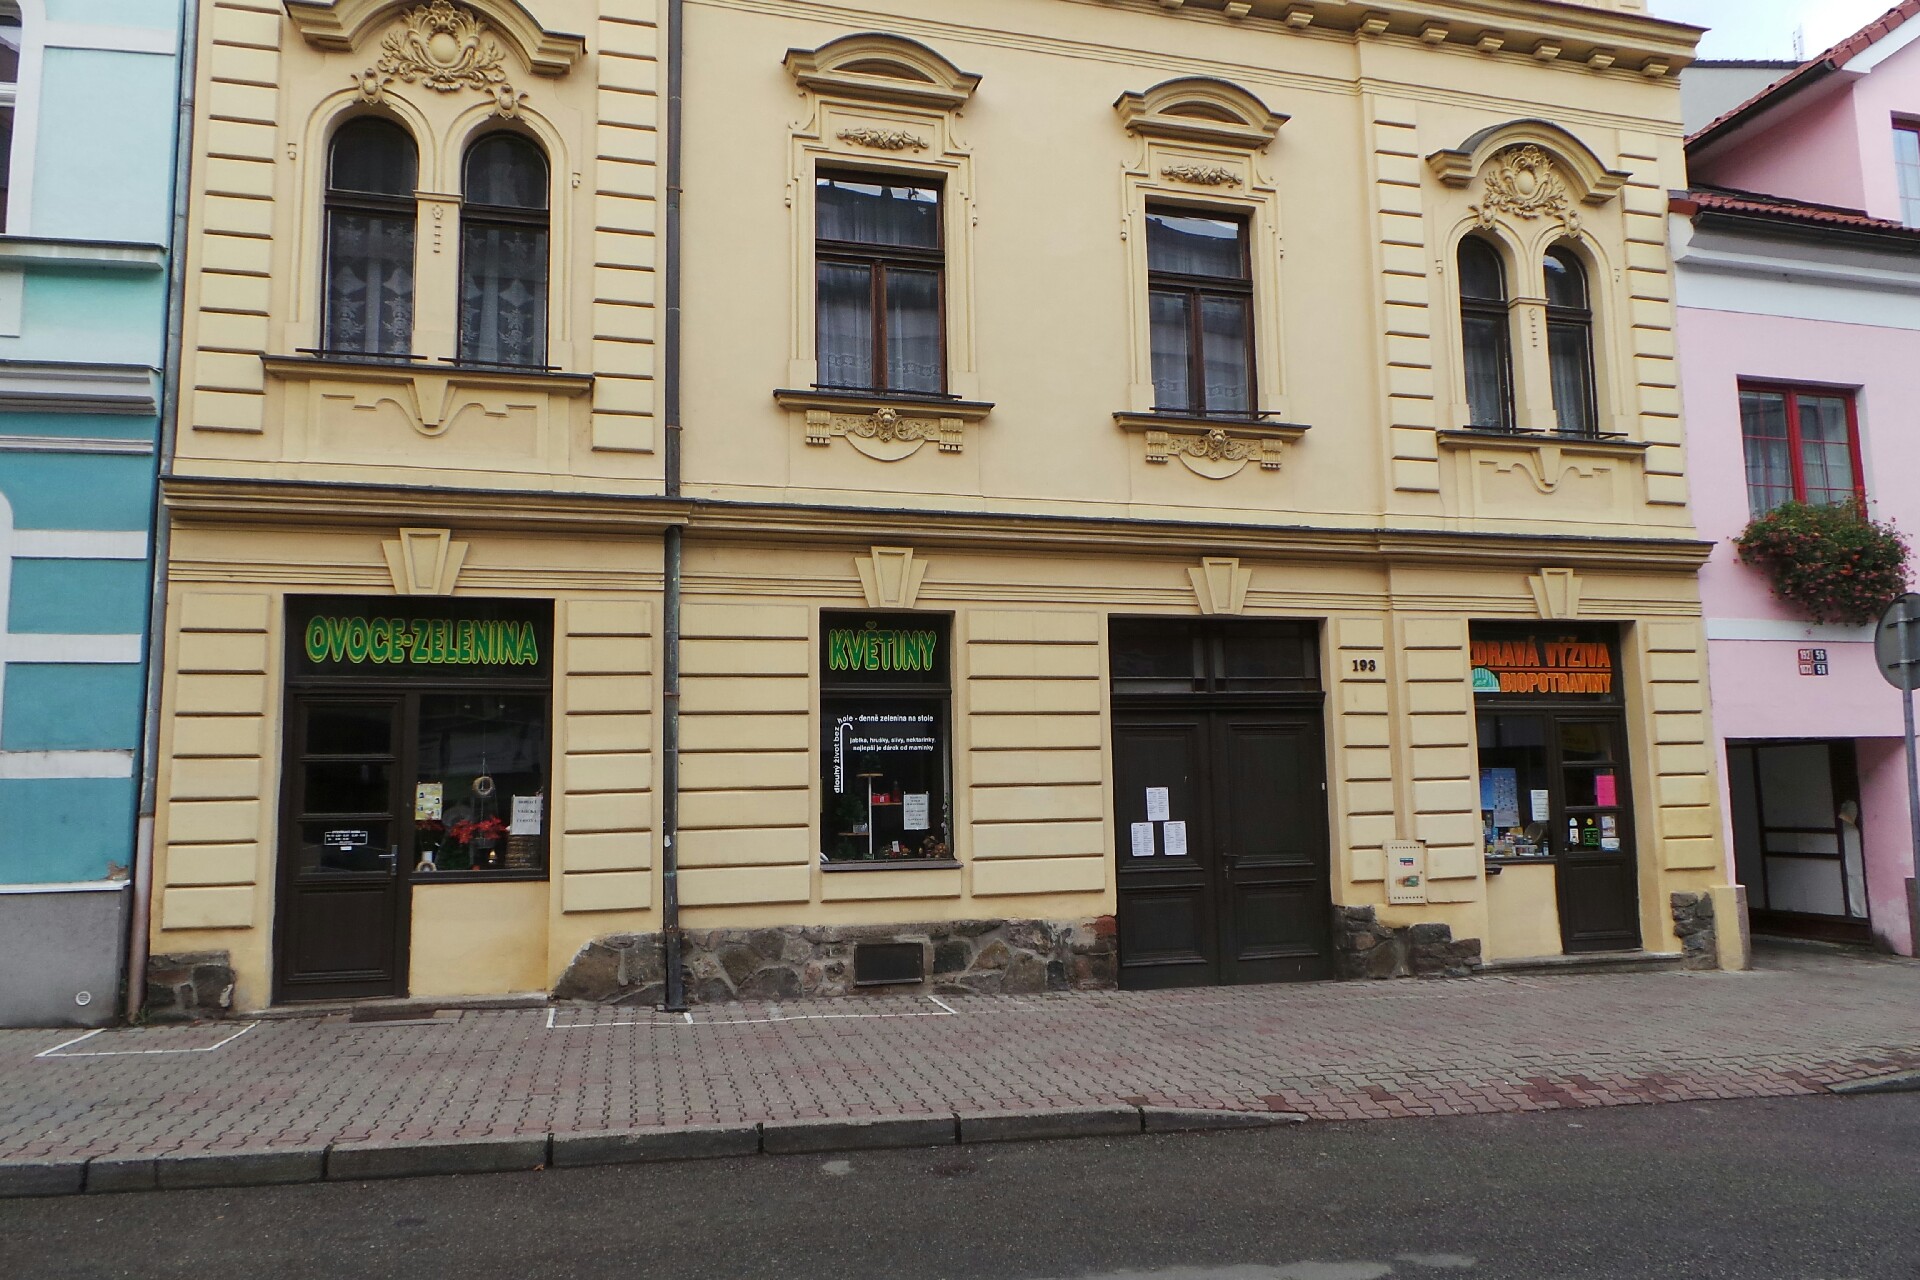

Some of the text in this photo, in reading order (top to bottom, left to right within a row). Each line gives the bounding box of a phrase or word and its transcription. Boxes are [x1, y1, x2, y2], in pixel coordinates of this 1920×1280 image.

[306, 615, 538, 665] OVOCE-ZELENINA
[829, 621, 937, 671] KVĚTINY
[1544, 637, 1611, 668] VÝŽIVA
[1352, 659, 1376, 672] 193
[1500, 672, 1611, 693] BIOPOTRAVINY
[833, 765, 841, 794] dlouhý
[837, 714, 853, 724] hole
[859, 714, 879, 722] denně
[880, 714, 907, 722] zelenina
[917, 714, 934, 722] stole
